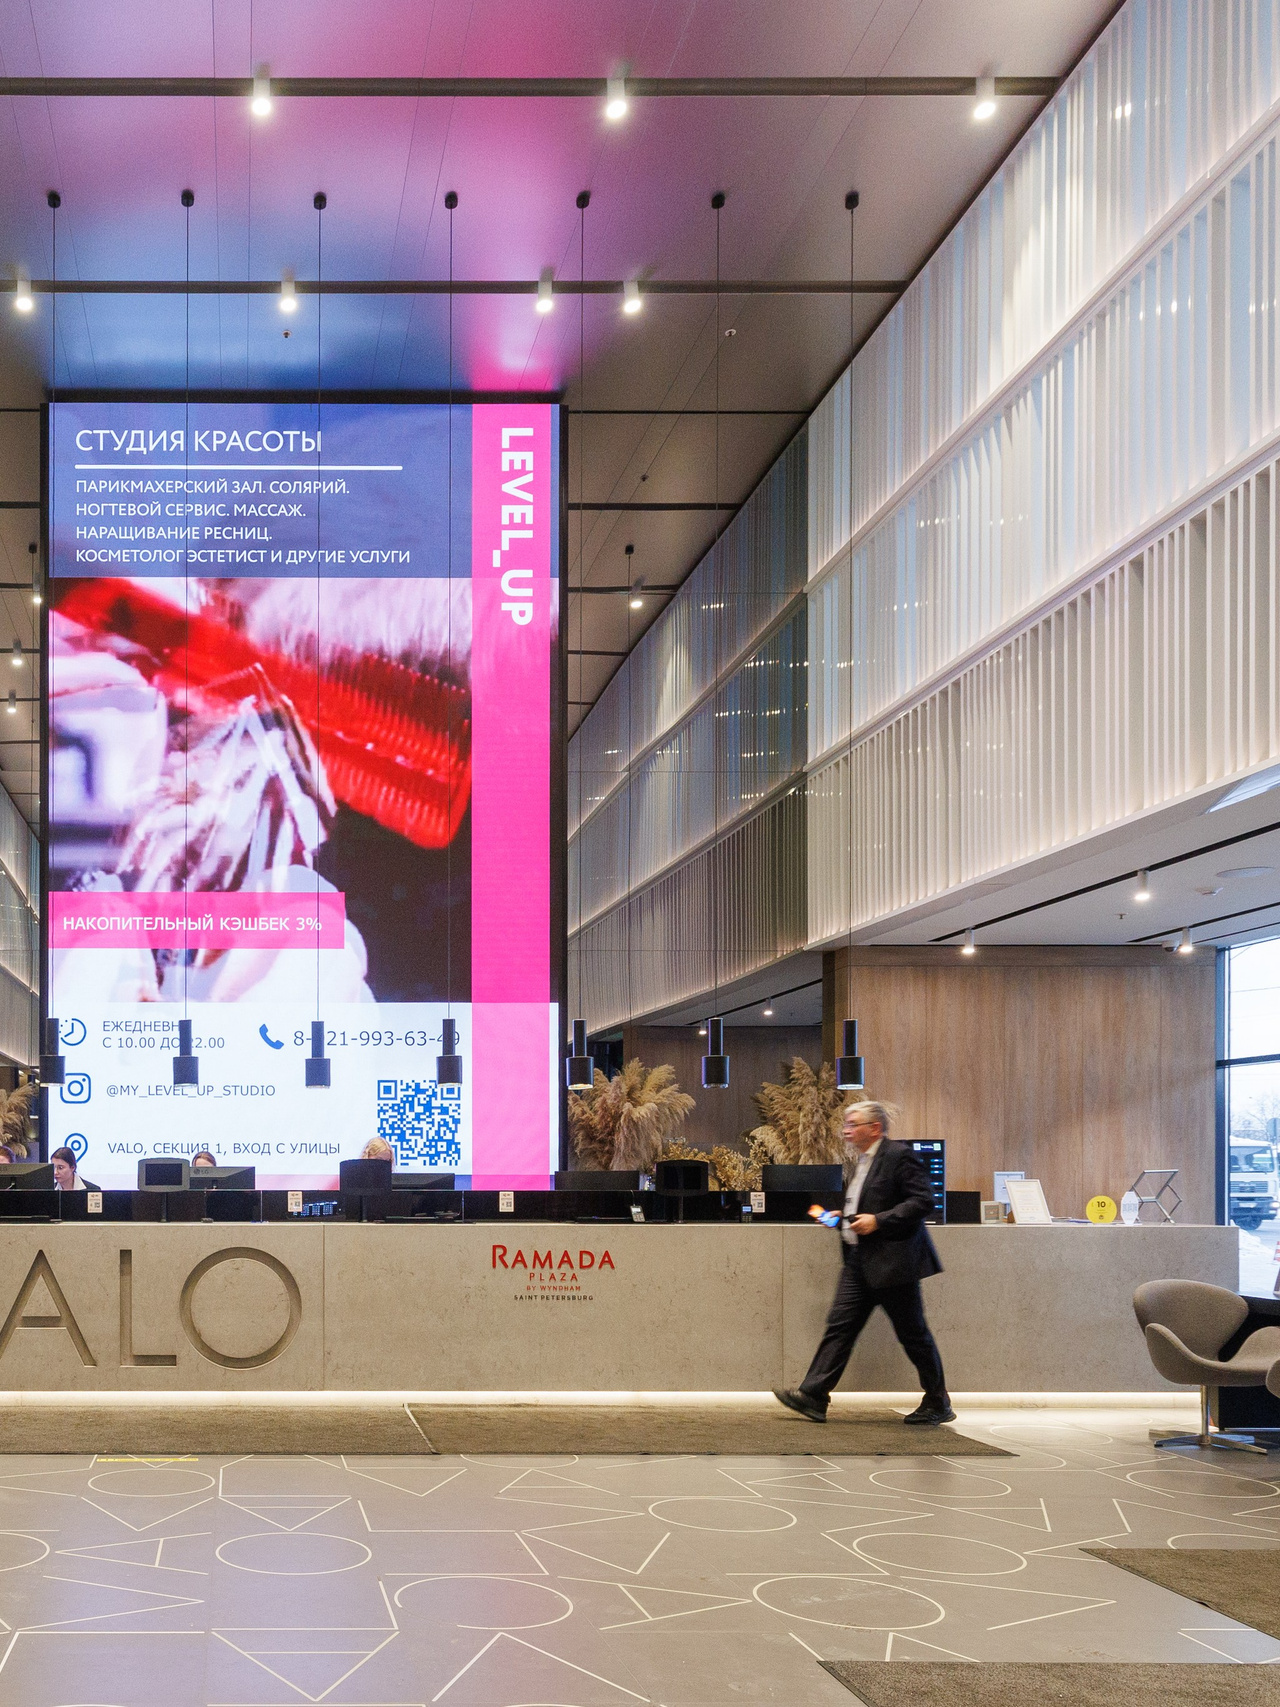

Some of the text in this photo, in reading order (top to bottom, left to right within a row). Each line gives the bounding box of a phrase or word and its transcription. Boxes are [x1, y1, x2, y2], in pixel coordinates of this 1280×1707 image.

[75, 429, 322, 454] СТУДИЯ КРАСОТЫ
[76, 478, 350, 494] ПАРИКМАХЕРСКИЙ ЗАЛ. СОЛЯРИЙ.
[76, 501, 306, 517] НОГТЕВОЙ СЕРВИС. МАССАЖ.
[76, 526, 273, 541] НАРАЩИВАНИЕ РЕСНИЦ.
[492, 427, 534, 626] LEVEL_UP
[76, 549, 410, 564] КОСМЕТОЛОГ ЭСТЕТИСТ И ДРУГИЕ УСЛУГИ
[63, 914, 322, 931] НАКОПИТЕЛЬНЫЙ КЭШБЕК 3%
[102, 1020, 180, 1033] ЕЖЕДНЕВН
[102, 1037, 111, 1048] С
[117, 1037, 155, 1048] 10.00
[191, 1037, 225, 1049] 2.00
[106, 1085, 276, 1098] @MY_LEVEL_UP_STUDIO
[107, 1143, 340, 1156] VALO, СЕКЦИЯ 1, ВХОД С УЛИЦЫ
[492, 1244, 616, 1270] RAMADA
[529, 1272, 579, 1281] PLAZA
